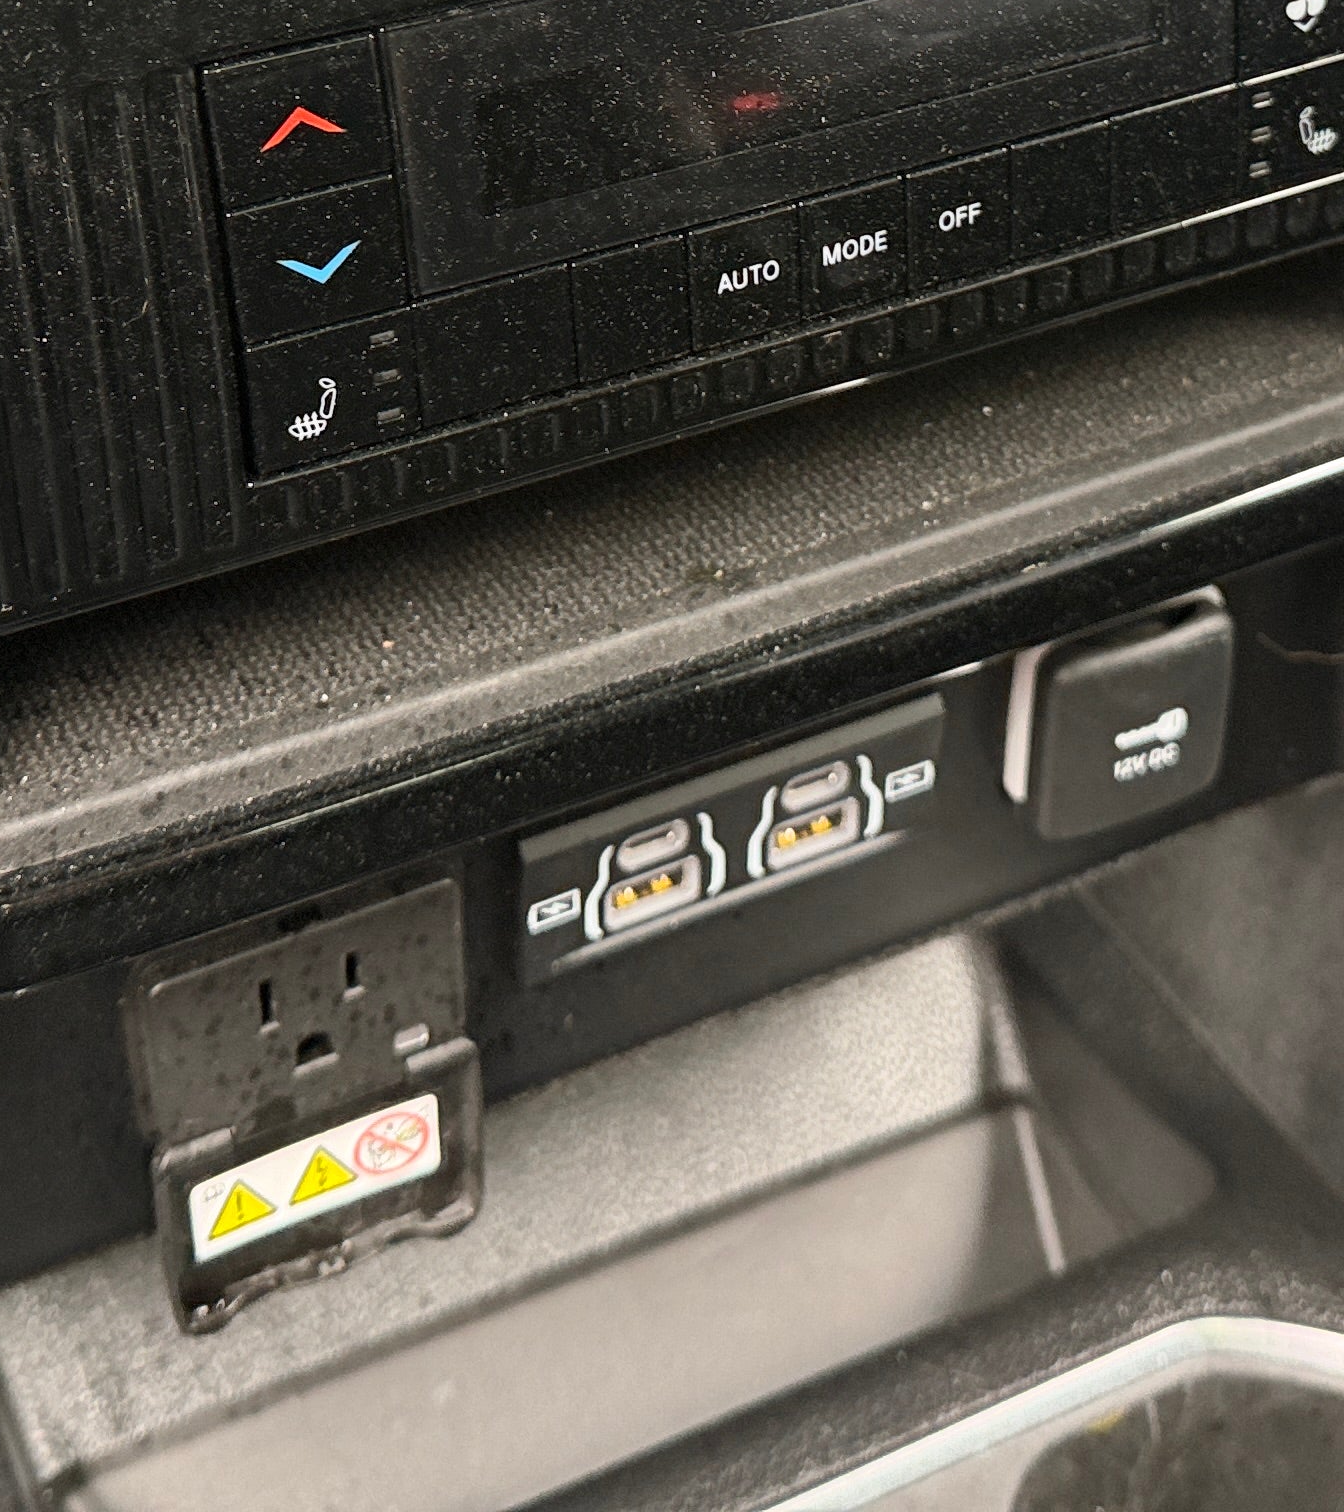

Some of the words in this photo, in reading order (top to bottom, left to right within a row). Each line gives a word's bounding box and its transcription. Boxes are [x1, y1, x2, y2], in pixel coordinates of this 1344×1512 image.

[938, 202, 982, 232] OFF
[822, 229, 888, 267] MODE
[717, 259, 780, 295] AUTO
